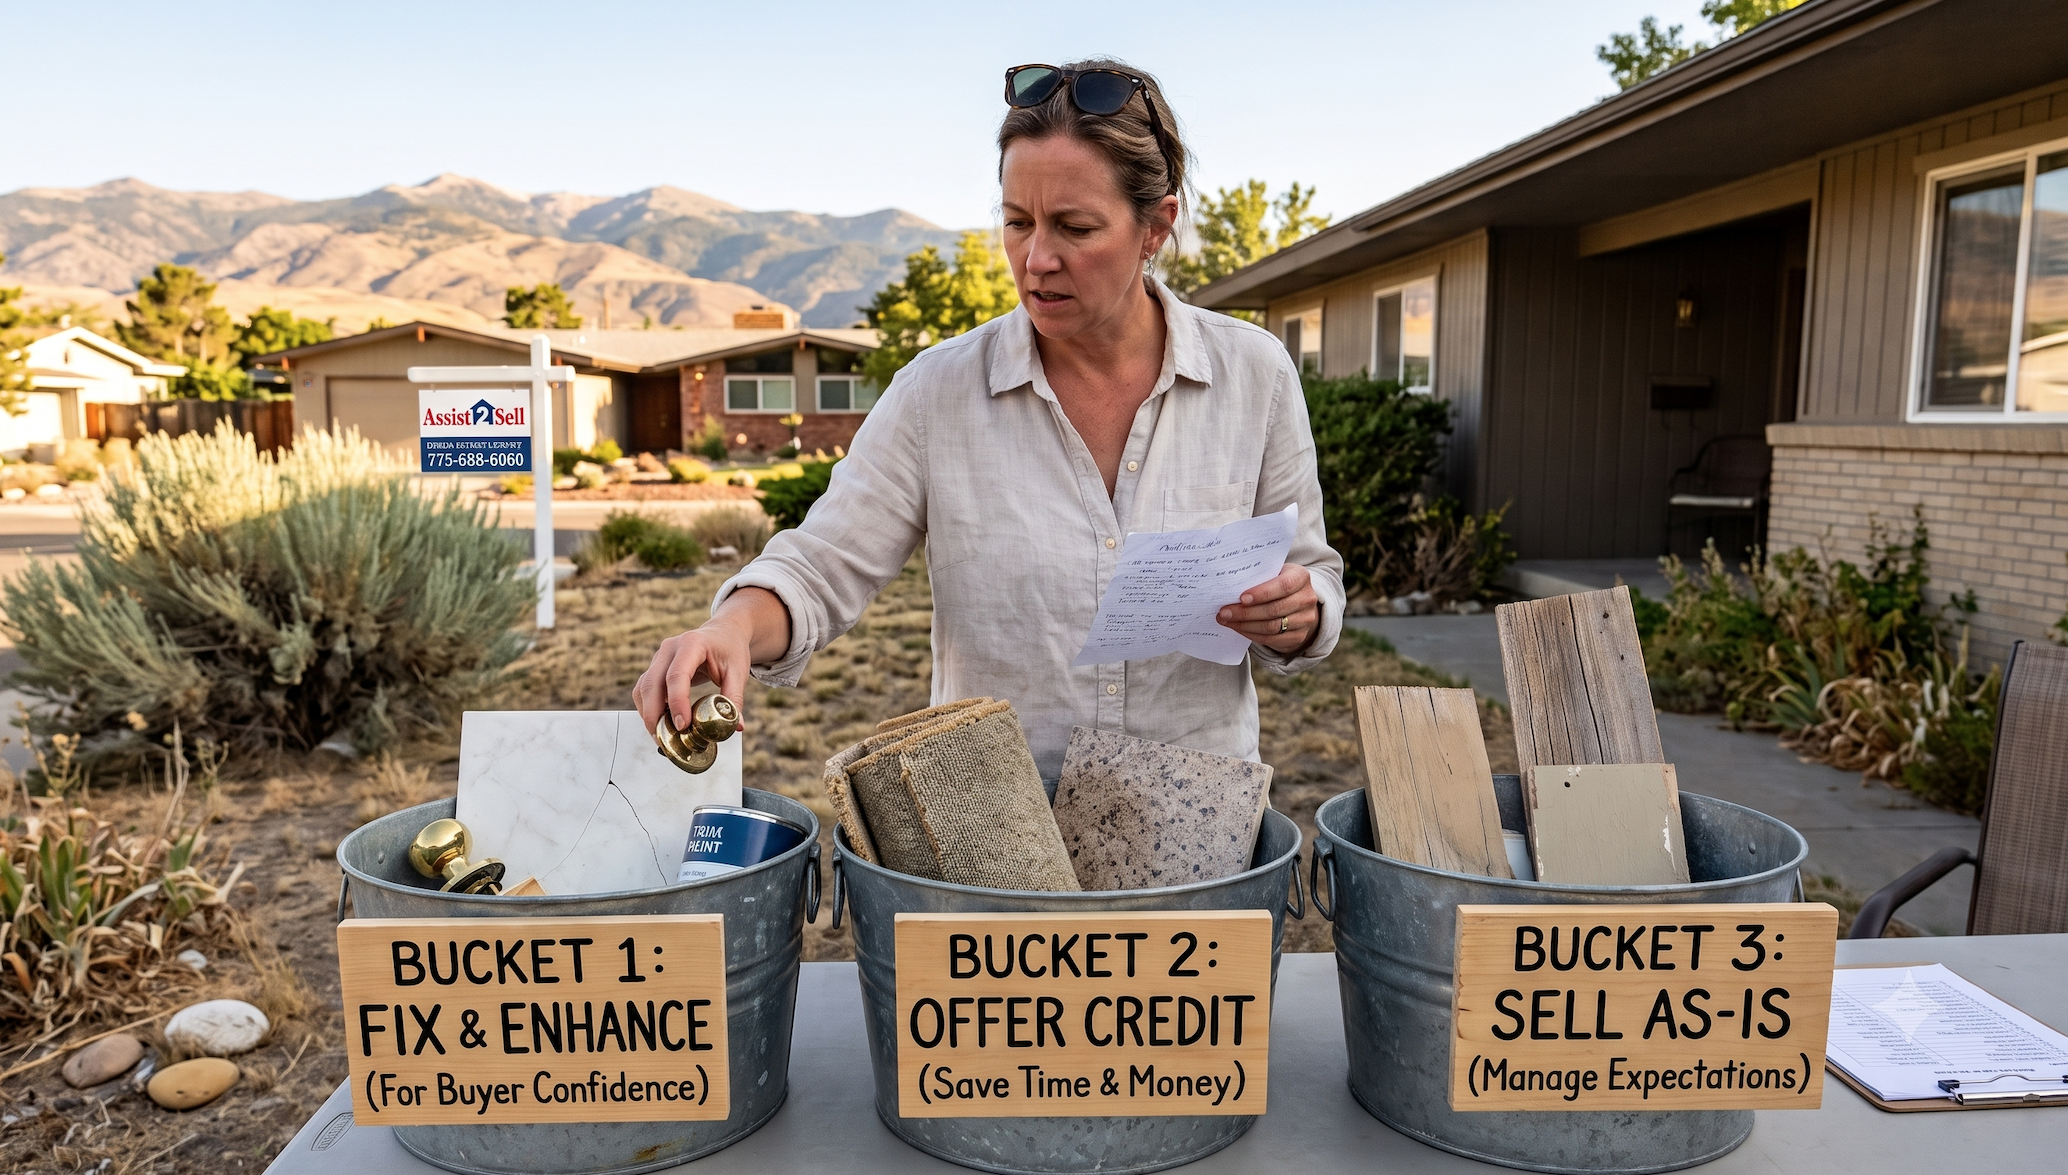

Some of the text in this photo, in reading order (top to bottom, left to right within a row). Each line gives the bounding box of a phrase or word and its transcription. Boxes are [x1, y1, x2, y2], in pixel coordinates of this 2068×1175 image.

[428, 452, 524, 467] 775-688-6060
[693, 825, 723, 838] TRIM
[391, 937, 664, 987] BUCKET 1:
[949, 931, 1218, 979] BUCKET 2:
[1514, 924, 1785, 972] BUCKET 3:
[359, 999, 714, 1057] FIX & ENHANCE
[909, 994, 1256, 1049] OFFER CREDIT
[1491, 989, 1624, 1041] SELL
[1642, 987, 1791, 1040] AS-IS
[366, 1064, 709, 1116] (For Buyer Confidence)
[918, 1059, 1246, 1106] (Save Time & Money)
[1468, 1052, 1811, 1102] (Manage Expectations)
